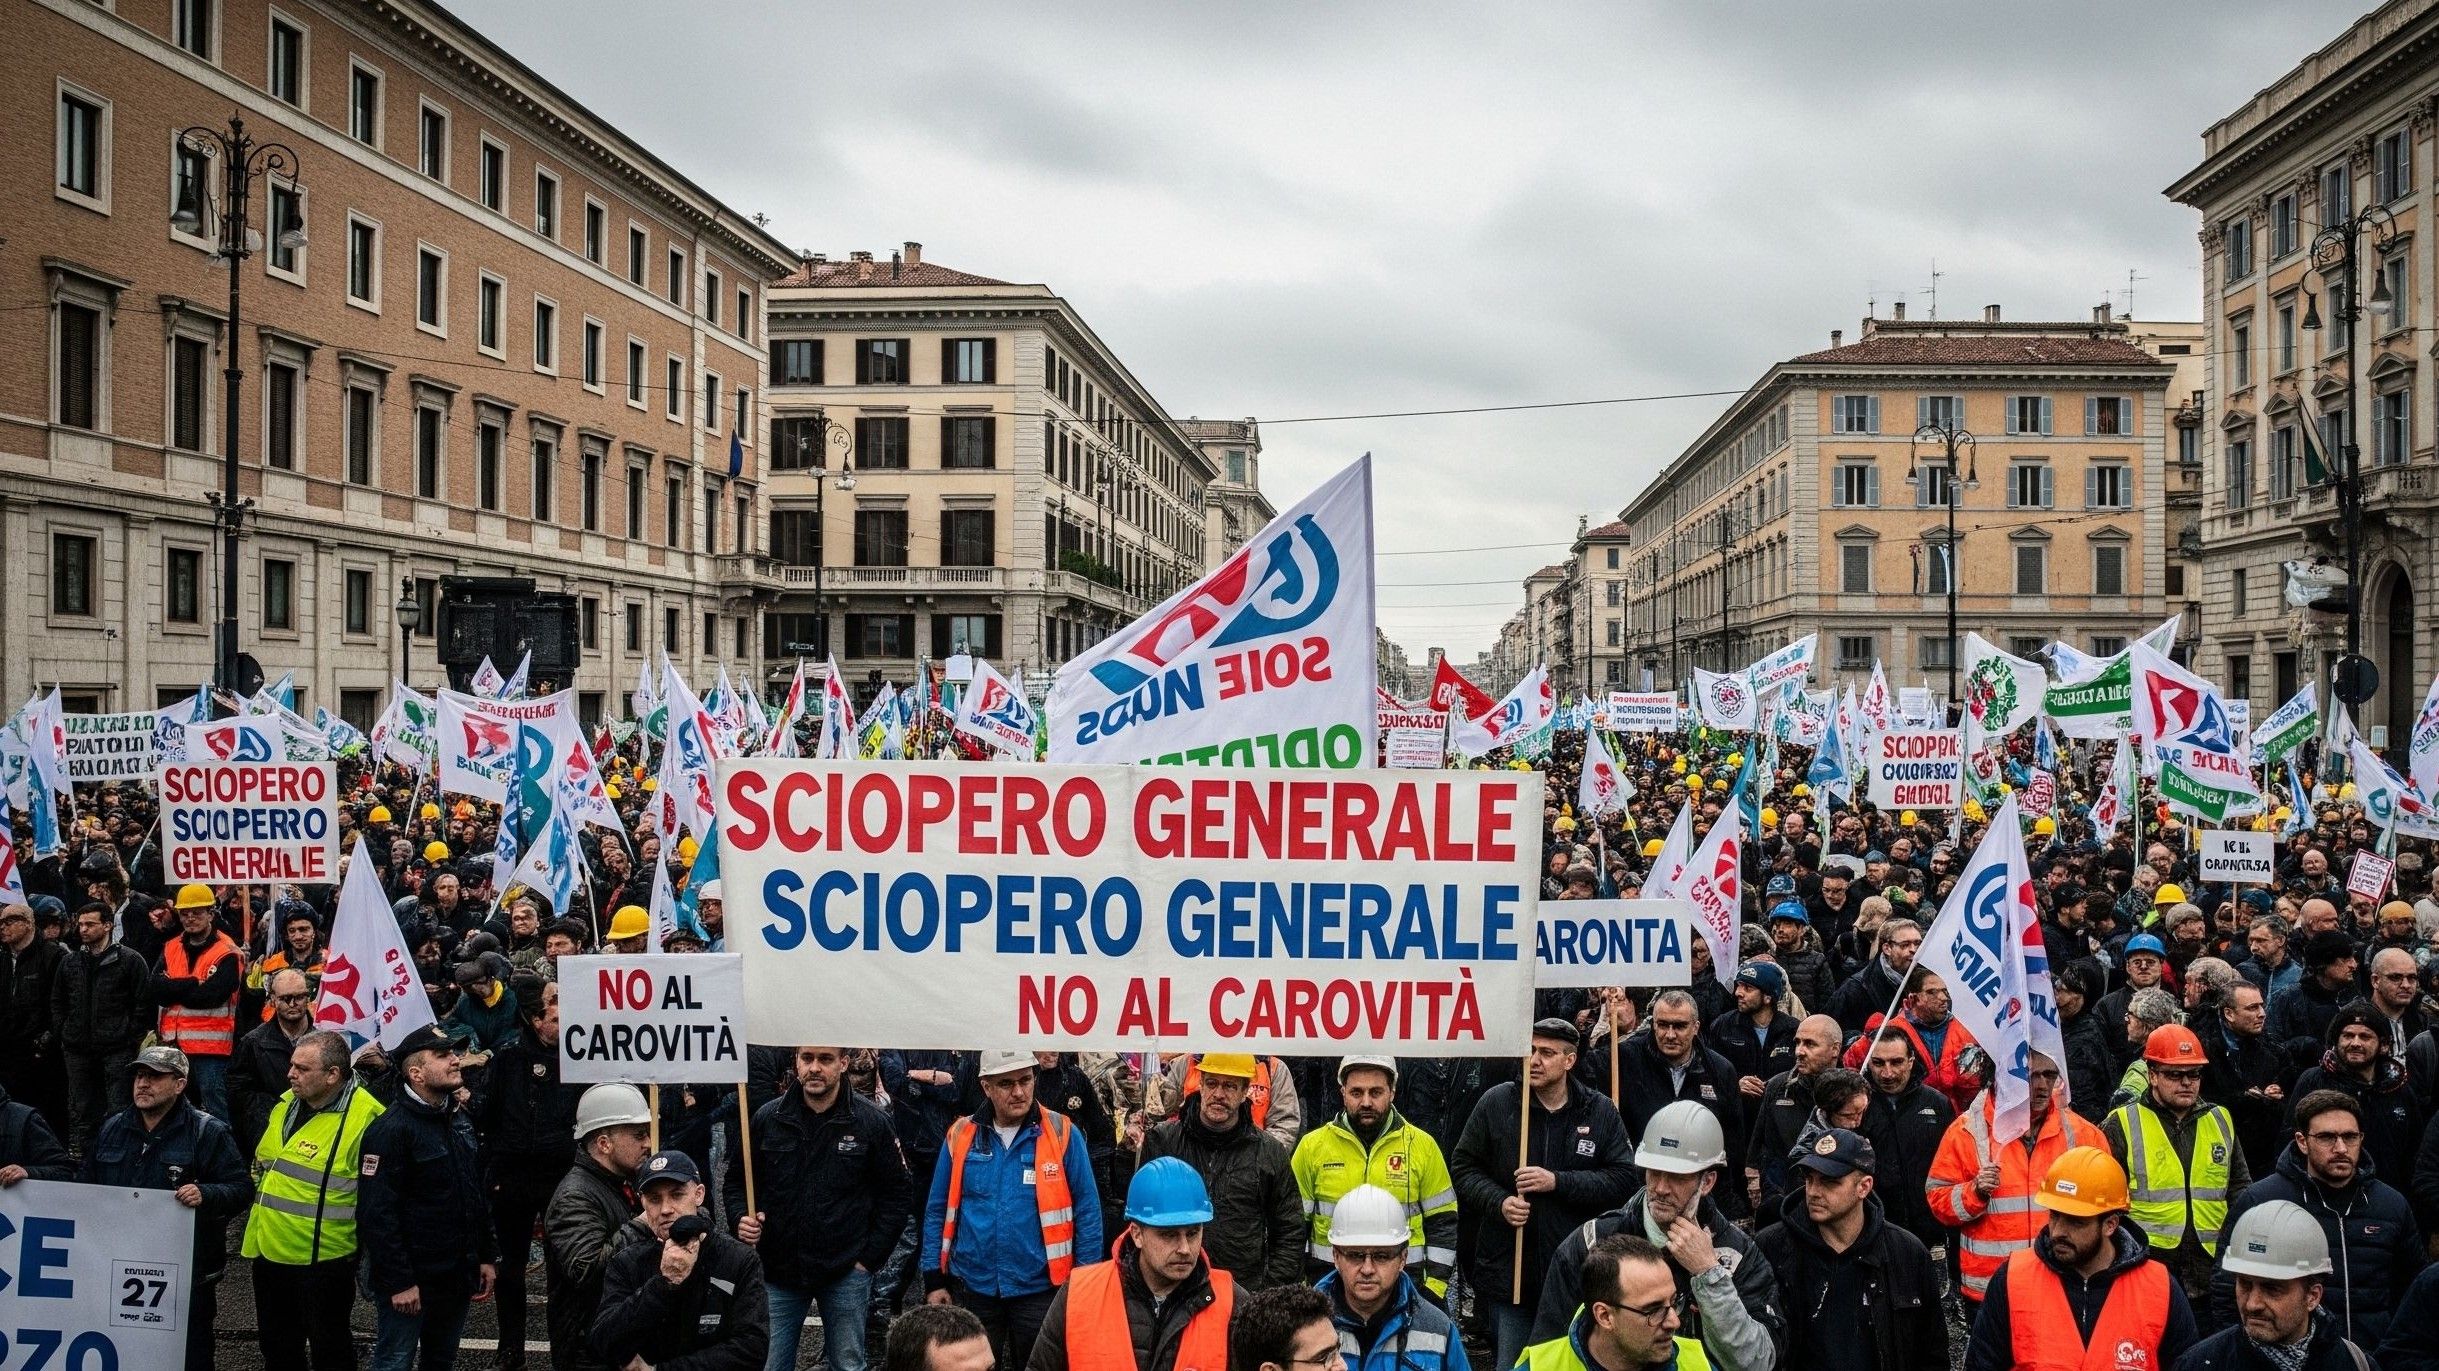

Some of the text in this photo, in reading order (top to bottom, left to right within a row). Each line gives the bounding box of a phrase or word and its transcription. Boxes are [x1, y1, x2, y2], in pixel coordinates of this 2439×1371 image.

[165, 766, 326, 803] SCIOPERO
[727, 769, 1518, 863] SCIOPERO GENERALE
[762, 868, 1521, 962] SCIOPERO GENERALE
[598, 969, 703, 1011] NO AL
[1019, 967, 1485, 1041] NO AL CAROVITÀ
[564, 1016, 739, 1062] CAROVITÀ
[121, 1277, 169, 1308] 27
